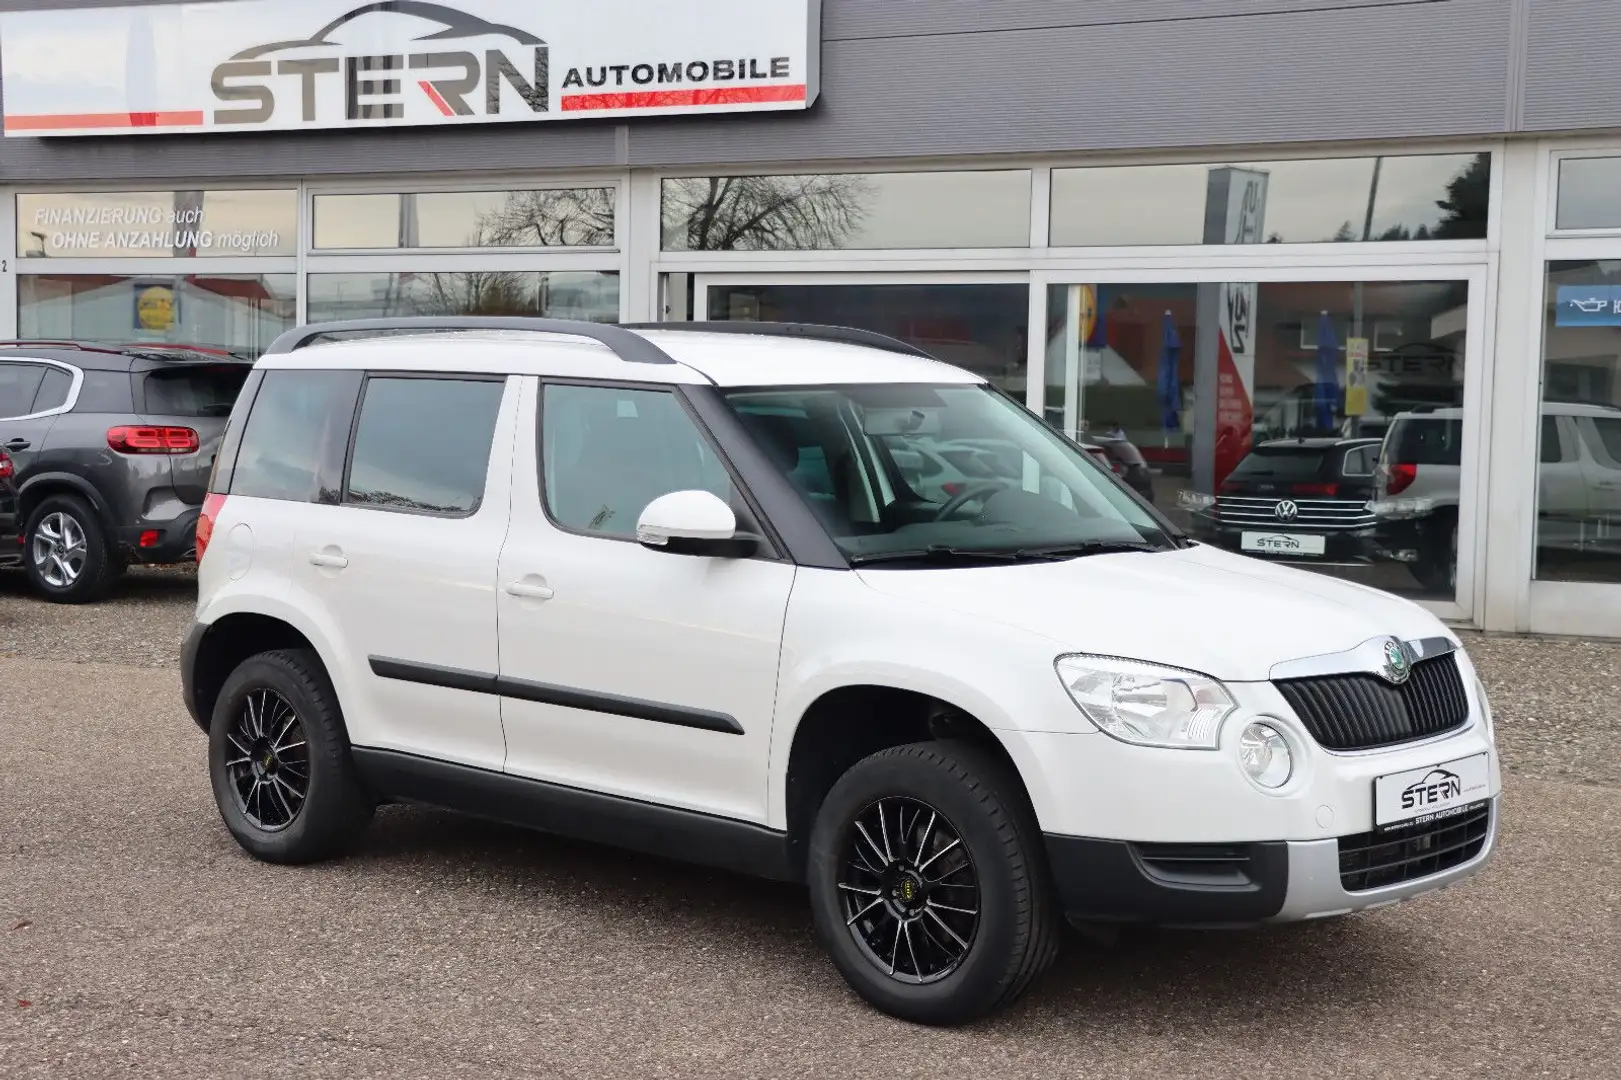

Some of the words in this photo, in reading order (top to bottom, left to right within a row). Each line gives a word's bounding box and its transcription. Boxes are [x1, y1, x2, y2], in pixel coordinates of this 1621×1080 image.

[211, 46, 549, 125] STERN
[561, 57, 790, 88] AUTOMOBILE
[34, 207, 164, 225] FINANZIERUNG
[167, 206, 205, 224] auch
[51, 231, 104, 248] OHNE
[105, 230, 213, 248] ANZAHLUNG
[216, 229, 279, 251] möglich
[1257, 539, 1300, 549] STERN
[1401, 779, 1461, 810] STERN
[1415, 813, 1436, 825] STERN
